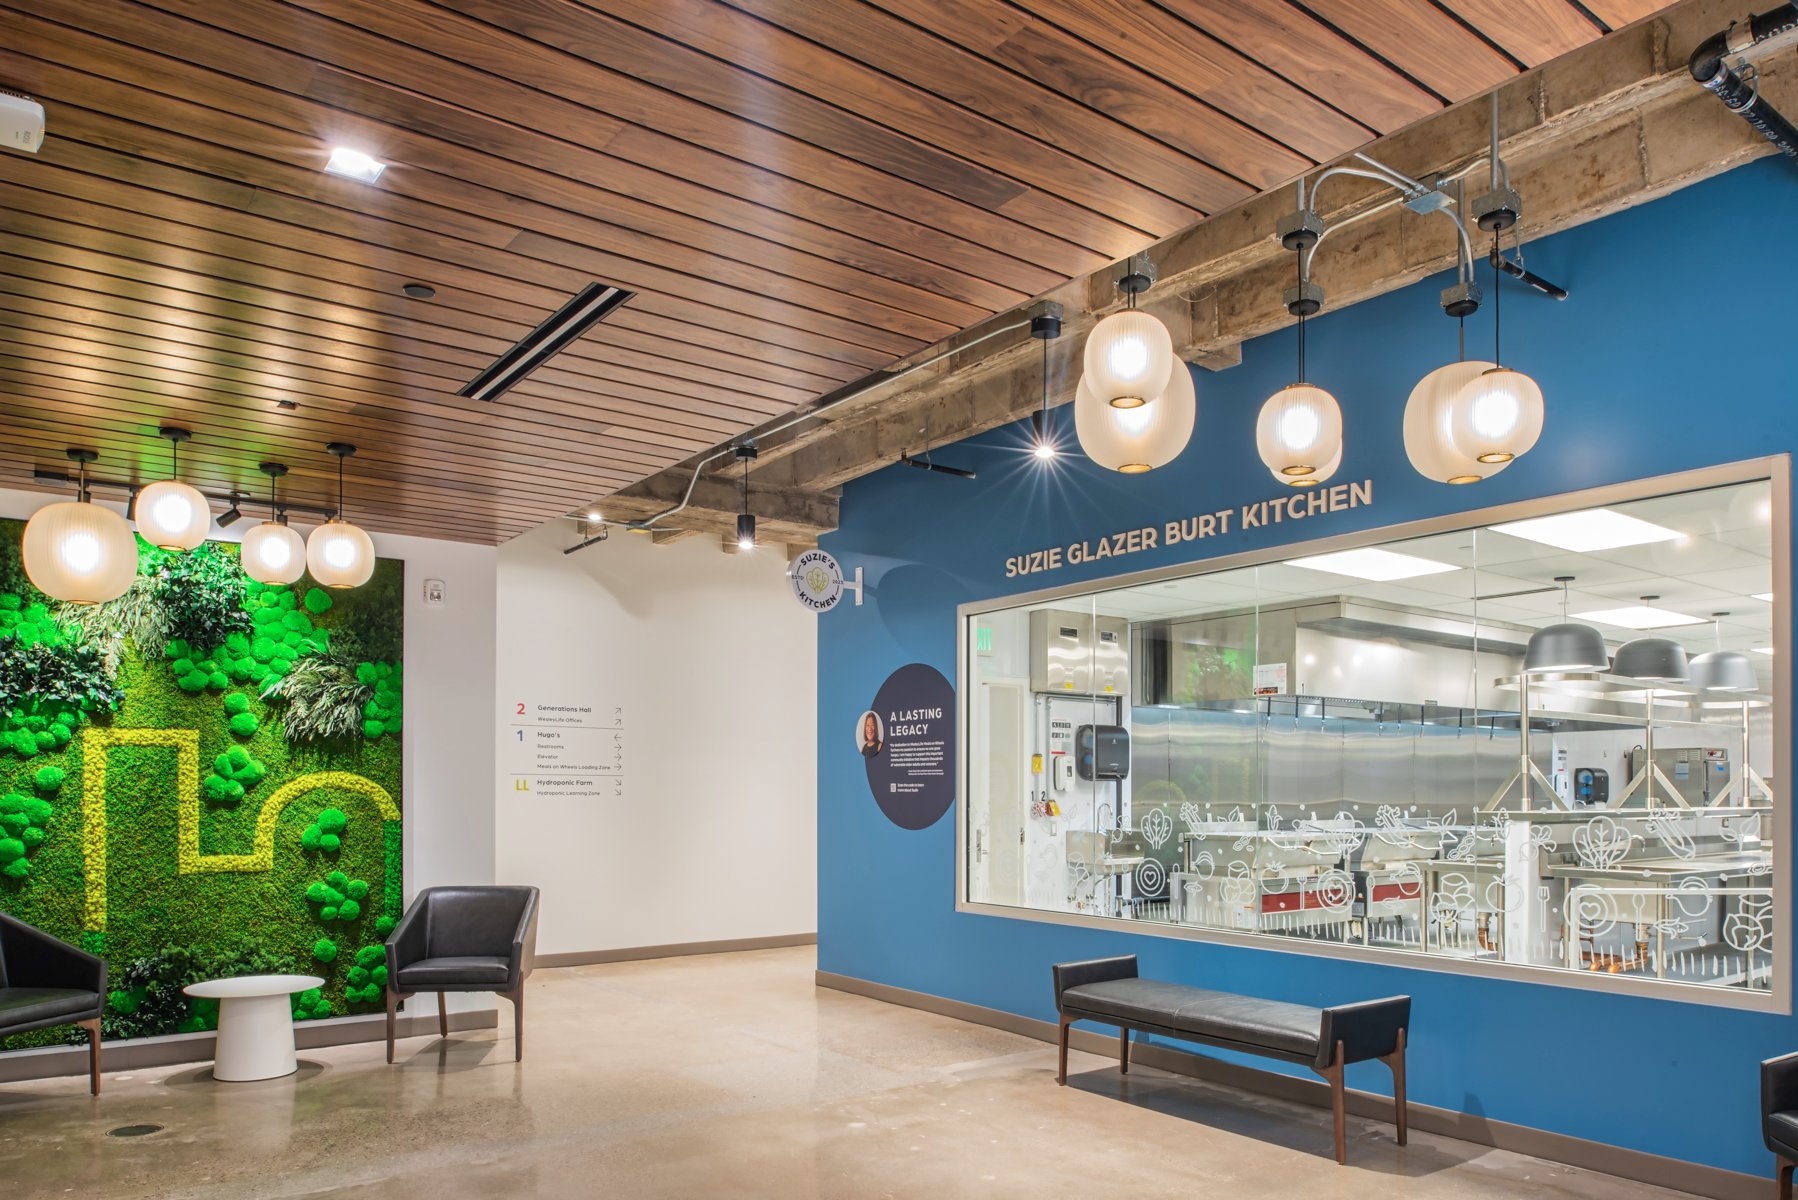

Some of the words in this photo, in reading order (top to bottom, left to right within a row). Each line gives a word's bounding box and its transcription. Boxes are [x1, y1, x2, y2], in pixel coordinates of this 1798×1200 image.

[1005, 547, 1063, 578] SUZIE
[1067, 527, 1158, 565] GLAZER
[1165, 509, 1234, 546] BURT
[1242, 479, 1373, 530] KITCHEN
[800, 553, 836, 570] SUZIE'S
[799, 591, 837, 609] KITCHEN
[976, 627, 993, 651] XIT
[516, 703, 526, 715] 2
[537, 705, 578, 713] Generations
[890, 711, 897, 722] A
[899, 708, 942, 722] LASTING
[517, 730, 523, 741] 1
[890, 723, 929, 737] LEGACY
[516, 779, 529, 791] LL
[1041, 790, 1046, 802] 2
